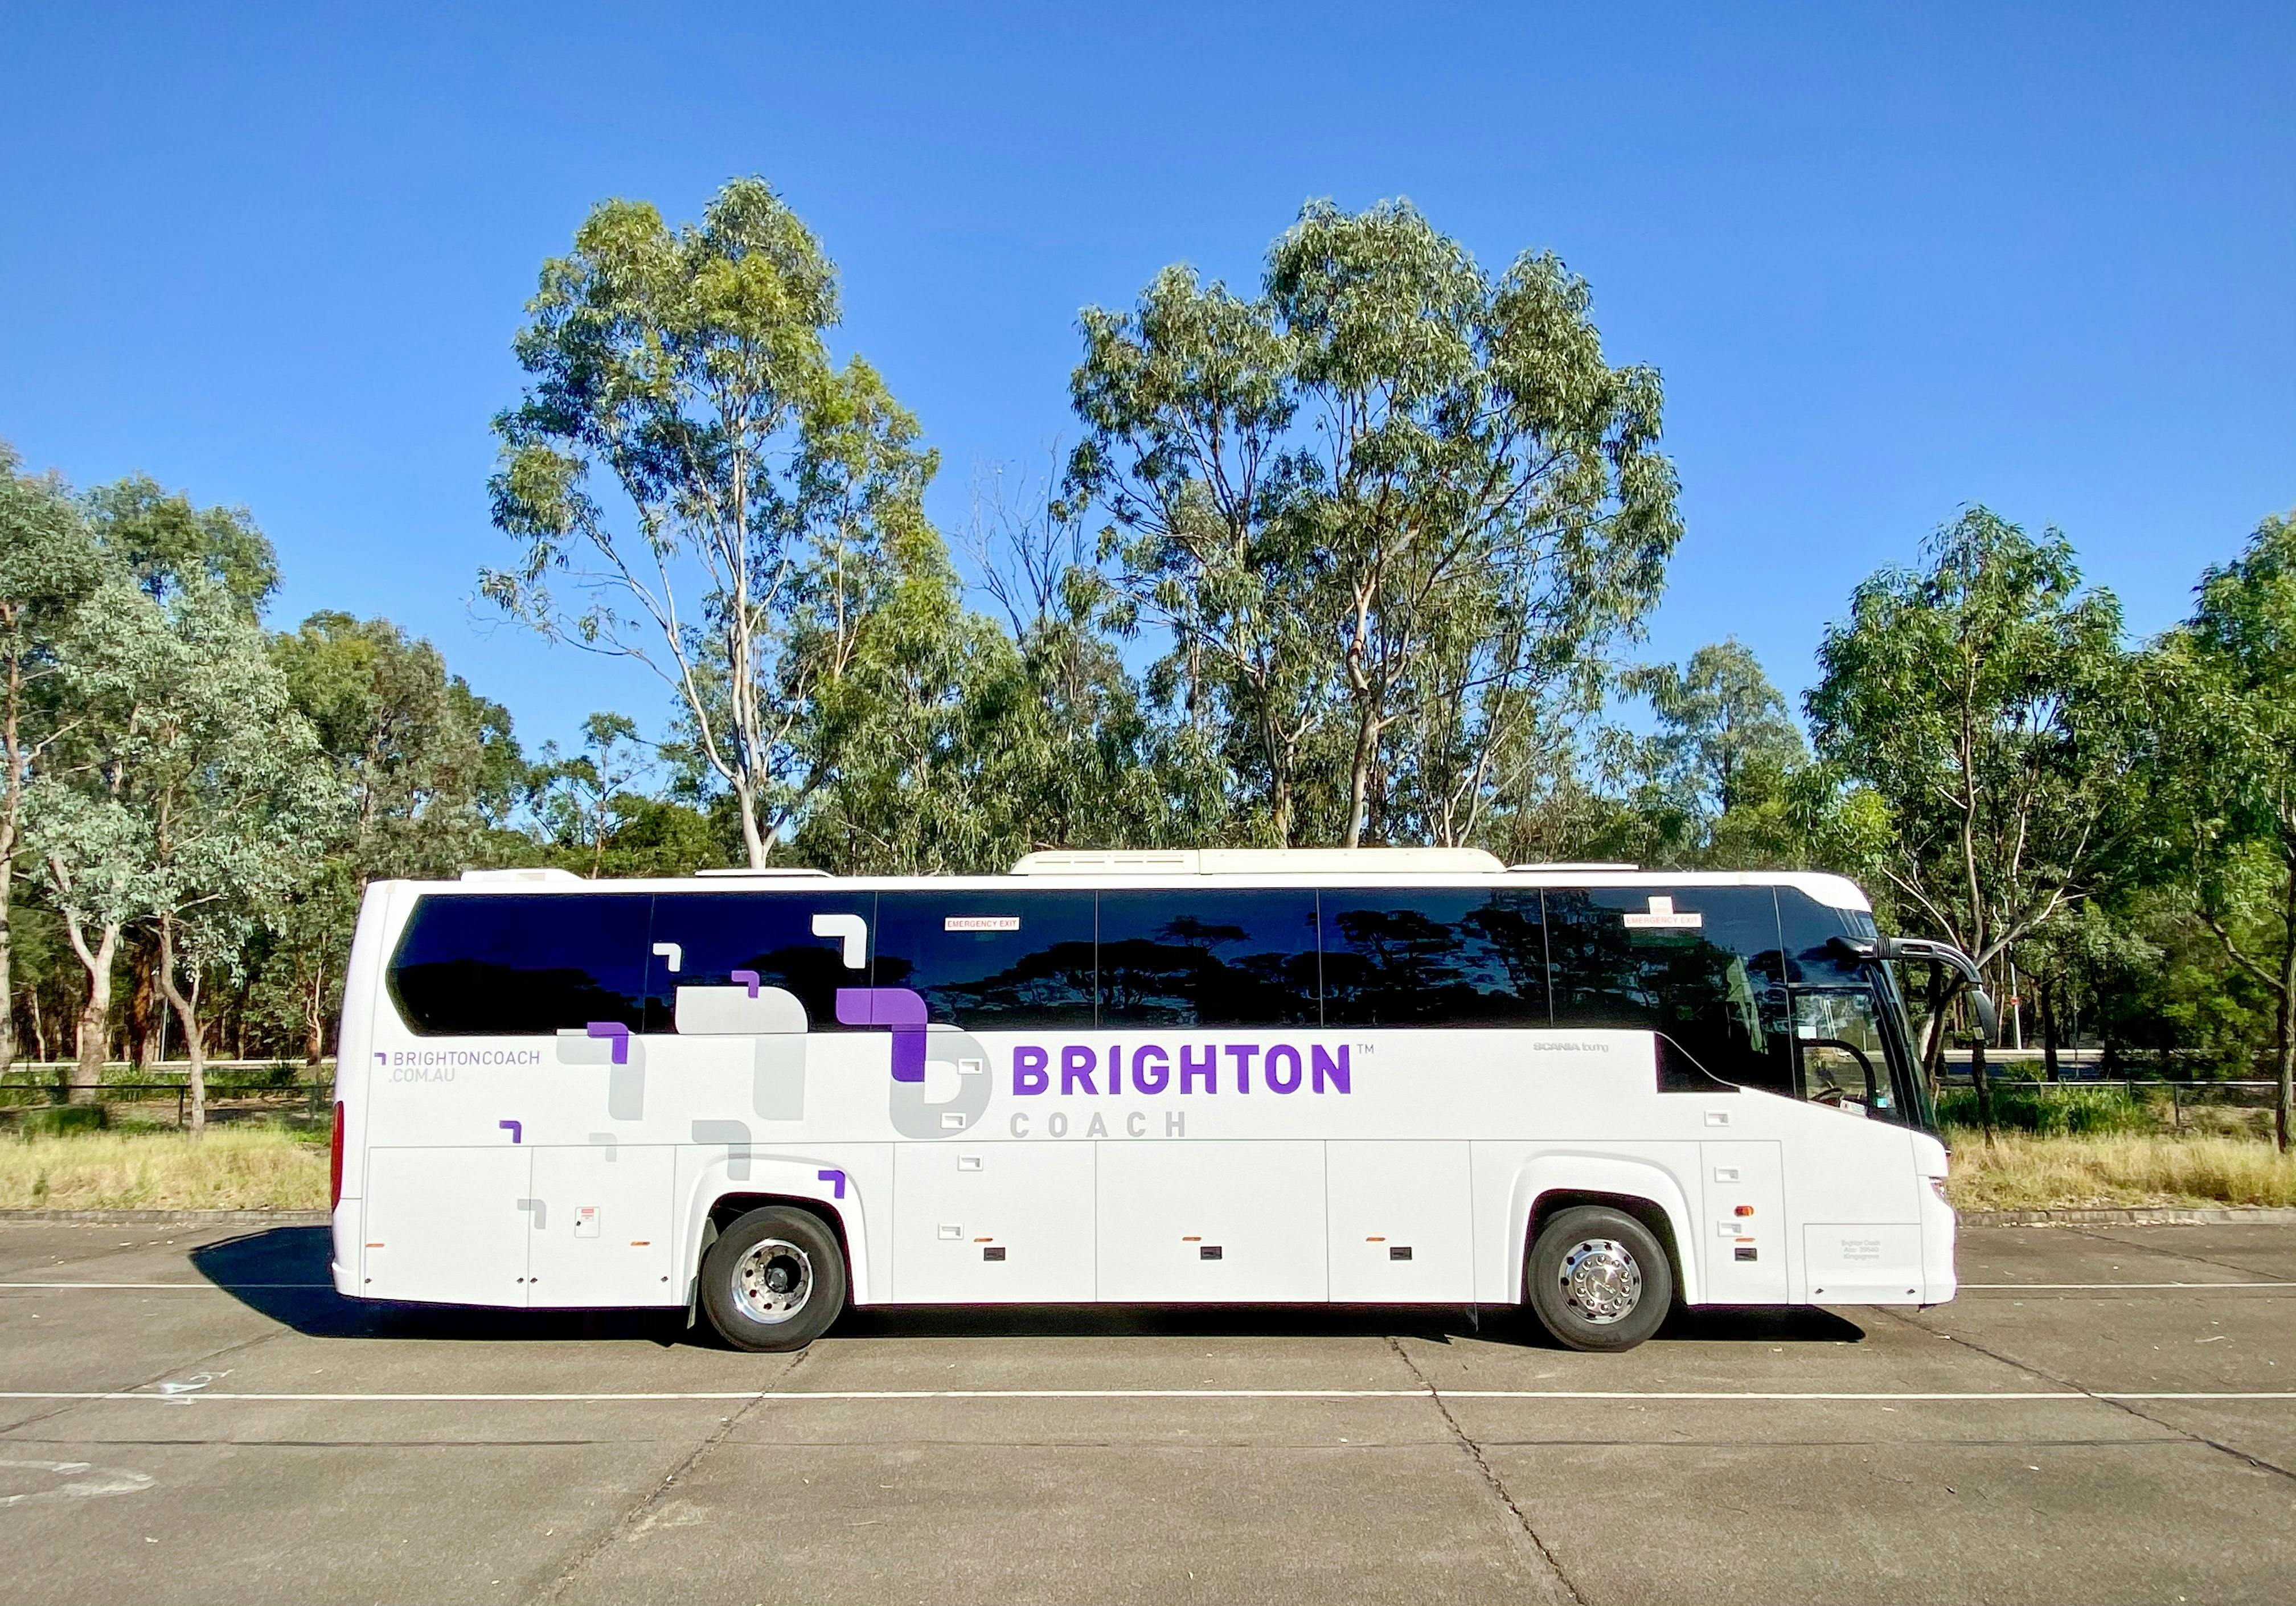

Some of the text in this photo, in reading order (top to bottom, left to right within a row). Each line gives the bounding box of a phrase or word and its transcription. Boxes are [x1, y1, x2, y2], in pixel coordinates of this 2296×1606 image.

[393, 1051, 540, 1066] BRIGHTONCOACH
[388, 1067, 456, 1083] .COM.AU
[1012, 1044, 1352, 1096] BRIGHTON
[1010, 1111, 1186, 1138] COACH
